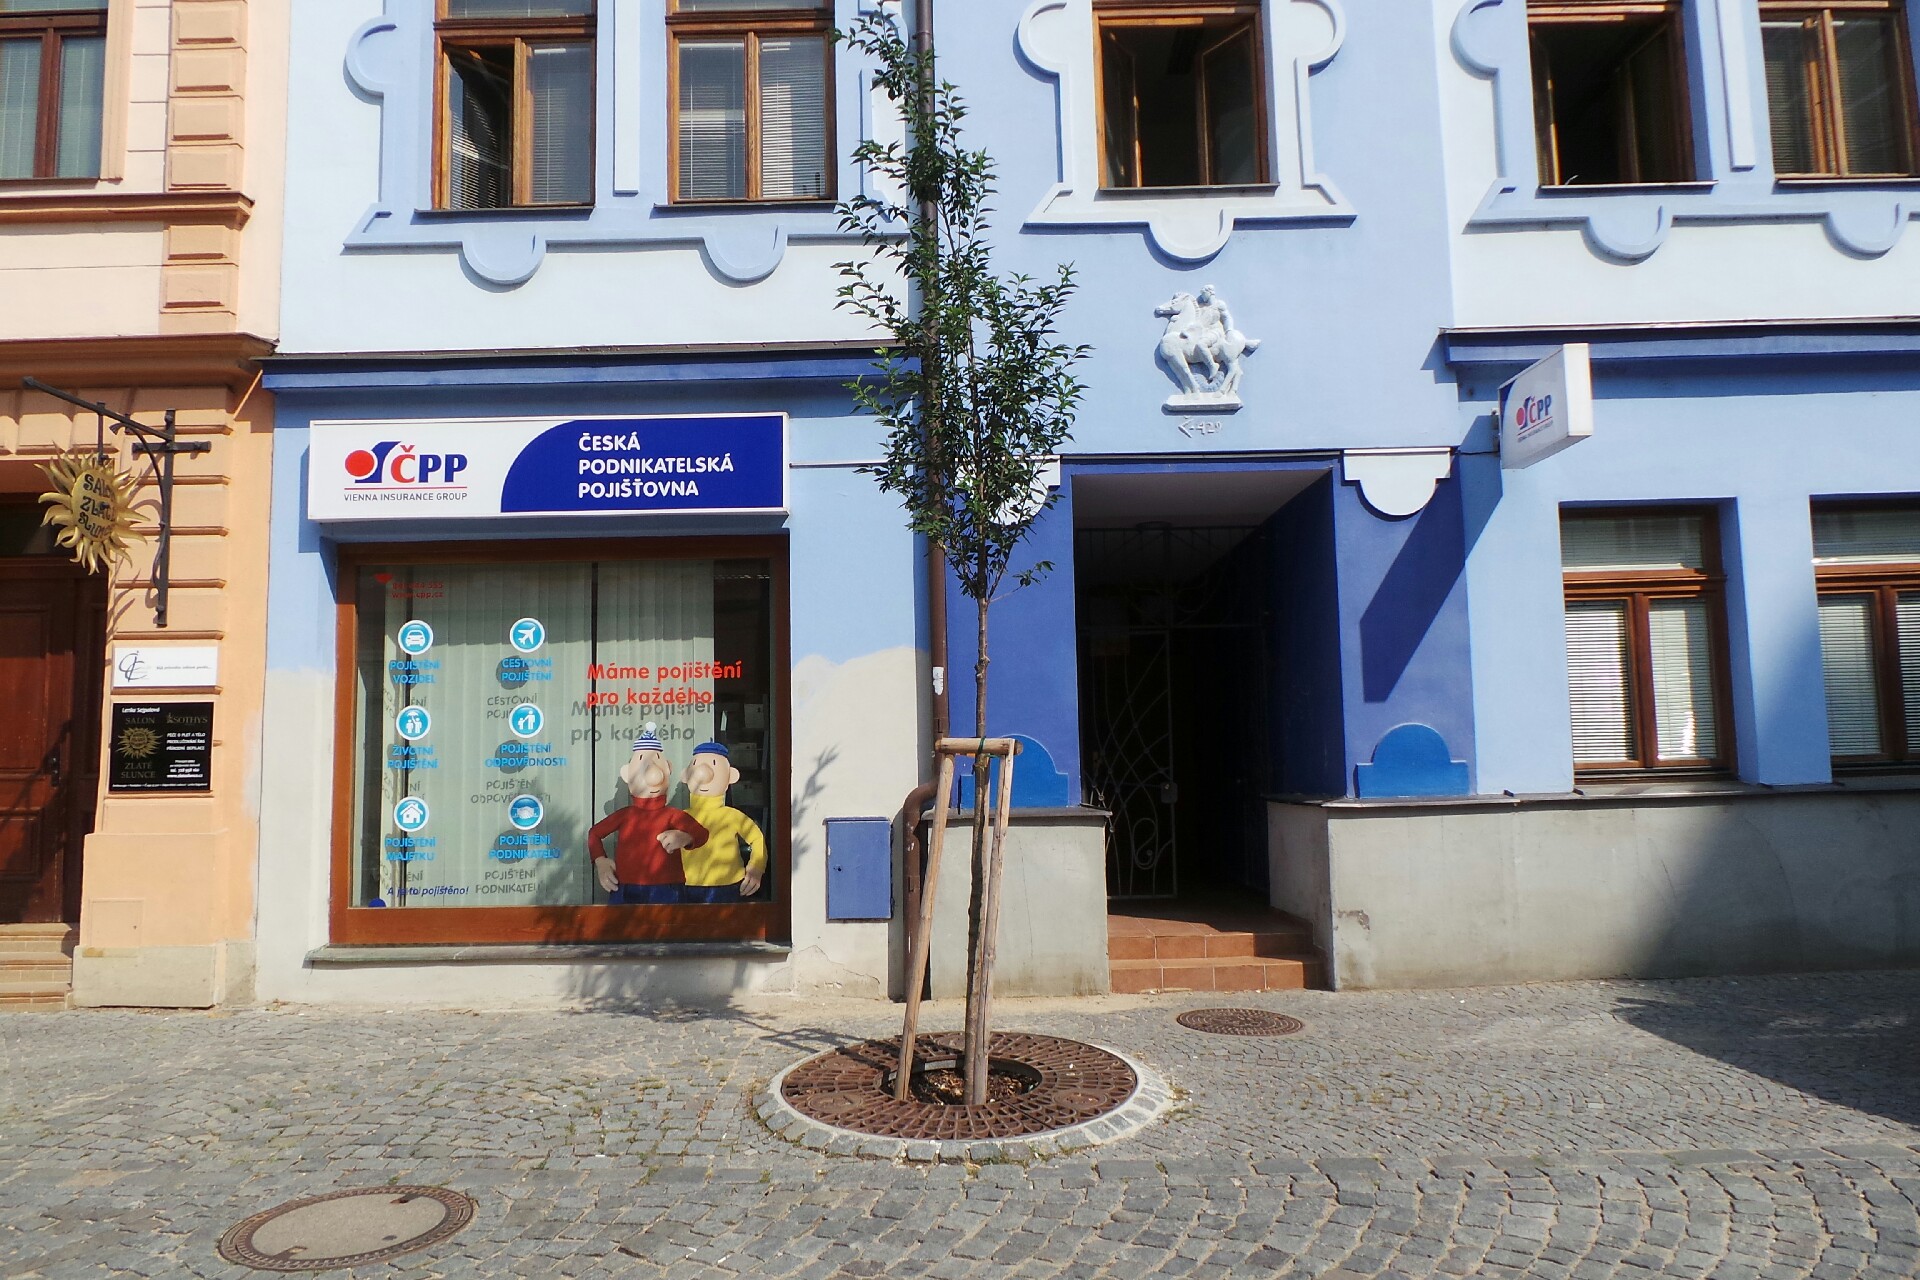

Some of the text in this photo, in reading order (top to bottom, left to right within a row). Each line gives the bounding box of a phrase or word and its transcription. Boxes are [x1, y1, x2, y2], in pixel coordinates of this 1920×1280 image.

[578, 431, 641, 451] ČESKÁ
[390, 444, 468, 483] ČPP
[578, 453, 734, 475] PODNIKATELSKÁ
[578, 478, 699, 499] POJIŠŤOVNA
[344, 492, 468, 502] VIENNA INSURANCE GROUP
[388, 658, 441, 670] POJIŠTĚNÍ
[502, 656, 552, 668] CESTOVNÍ
[501, 669, 553, 681] POJIŠTĚNÍ
[587, 660, 742, 683] Máme pojištění
[392, 673, 437, 684] VOZIDEL
[586, 687, 712, 709] pro každého
[125, 717, 156, 725] SALON
[392, 744, 434, 756] ŽIVOTNÍ
[500, 742, 552, 754] POJIŠTĚNÍ
[124, 760, 152, 770] ZLATÉ
[387, 757, 439, 769] POJIŠTĚNÍ
[485, 755, 568, 767] ODPOVĚDNOSTI
[121, 771, 155, 779] SLUNCE
[385, 836, 437, 848] POJIŠTĚNÍ
[499, 834, 551, 846] POJIŠTĚNÍ
[386, 851, 436, 862] MAJETKU
[488, 847, 561, 859] PODNIKATELŮ
[387, 887, 394, 896] A
[409, 886, 419, 895] to
[422, 885, 470, 898] pojištěno!
